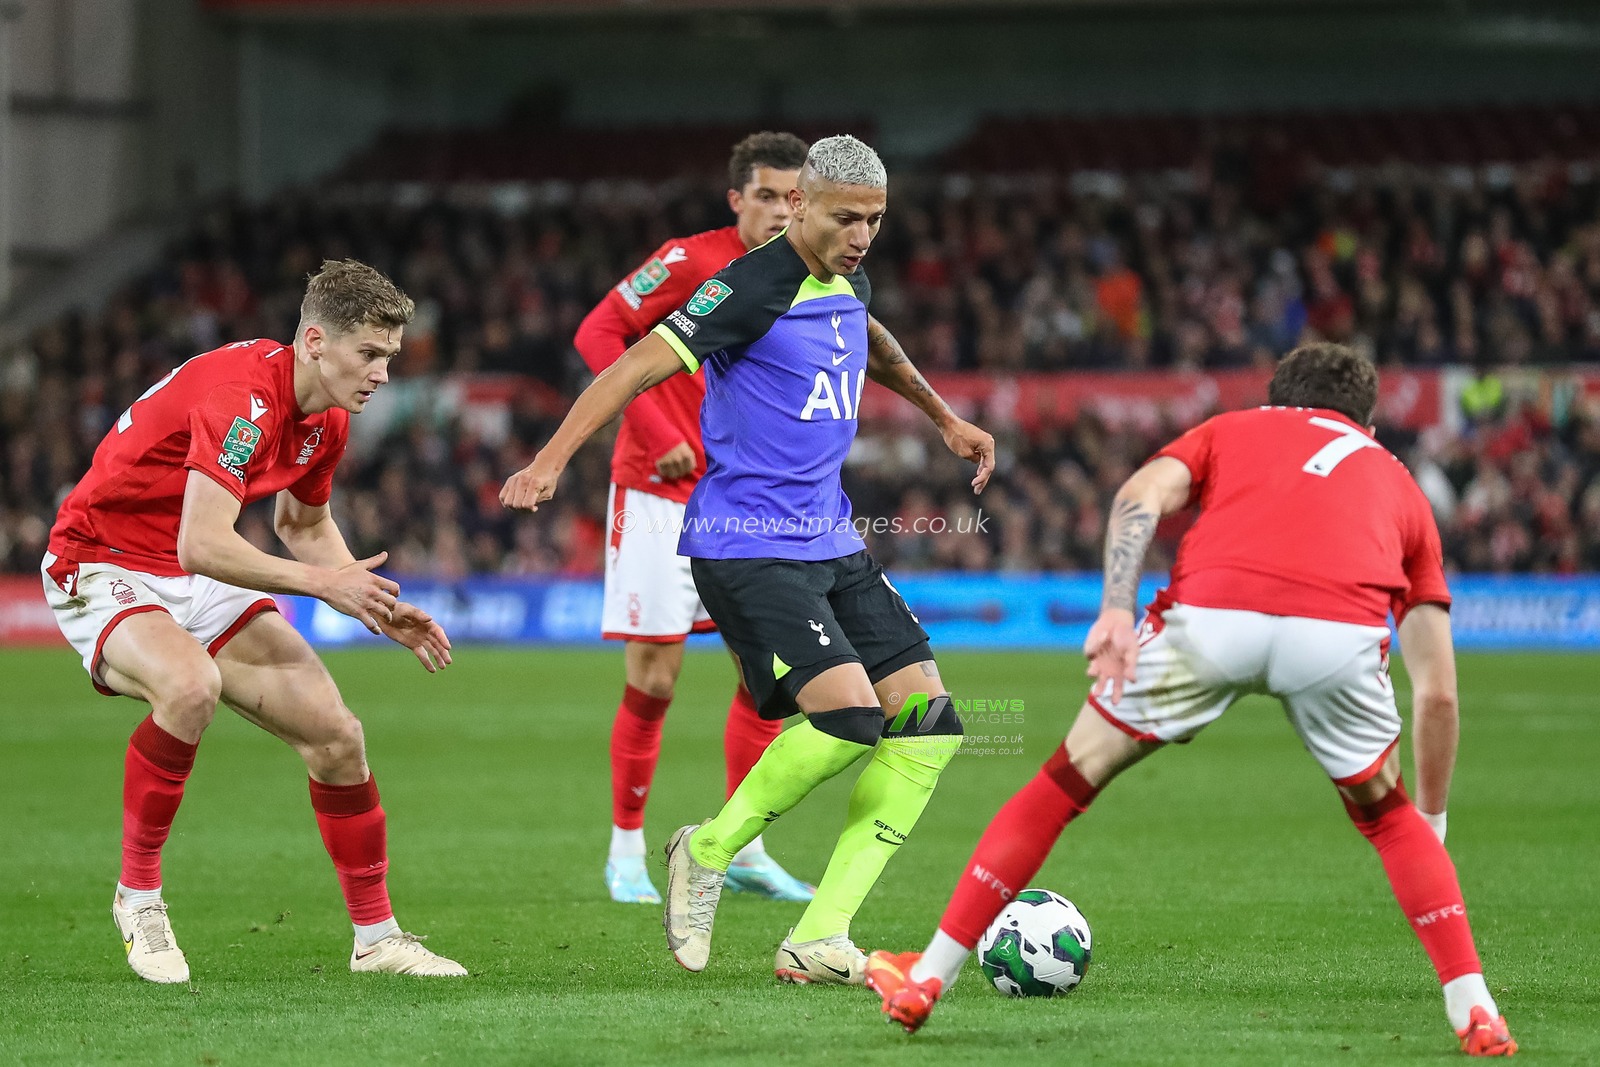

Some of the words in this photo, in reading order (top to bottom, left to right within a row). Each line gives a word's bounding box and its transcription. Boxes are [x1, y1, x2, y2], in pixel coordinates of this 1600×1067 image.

[231, 444, 246, 453] Cup
[1302, 416, 1384, 478] 7
[972, 864, 1012, 900] NFFC
[1416, 904, 1464, 927] NFFC
